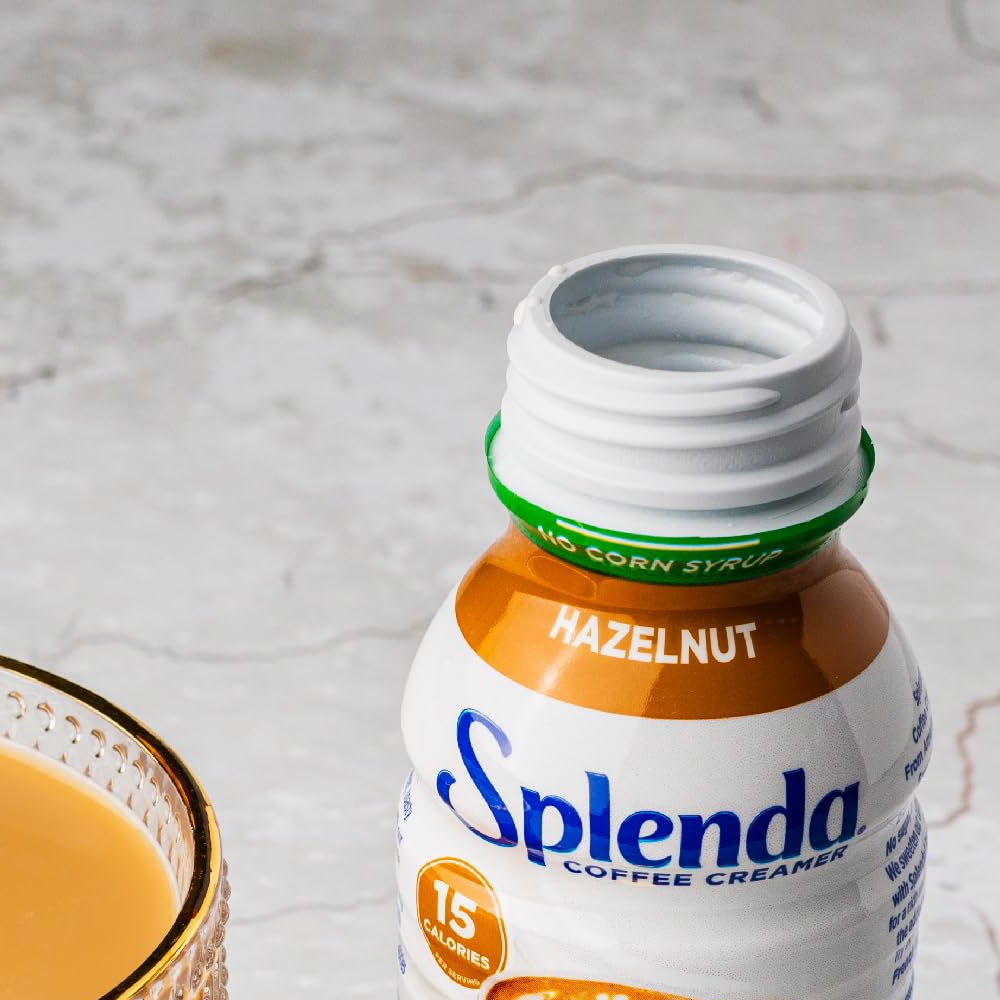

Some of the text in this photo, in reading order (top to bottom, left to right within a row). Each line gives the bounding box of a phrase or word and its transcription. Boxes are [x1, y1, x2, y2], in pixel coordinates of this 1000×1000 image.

[538, 524, 784, 574] NO CORN SYRUP
[548, 604, 756, 665] HAZELNUT
[435, 708, 863, 867] Splenda
[563, 845, 849, 886] COFFEE CREAMER
[433, 879, 477, 939] 15
[423, 917, 490, 970] CALORIES
[448, 967, 481, 986] SERVING
